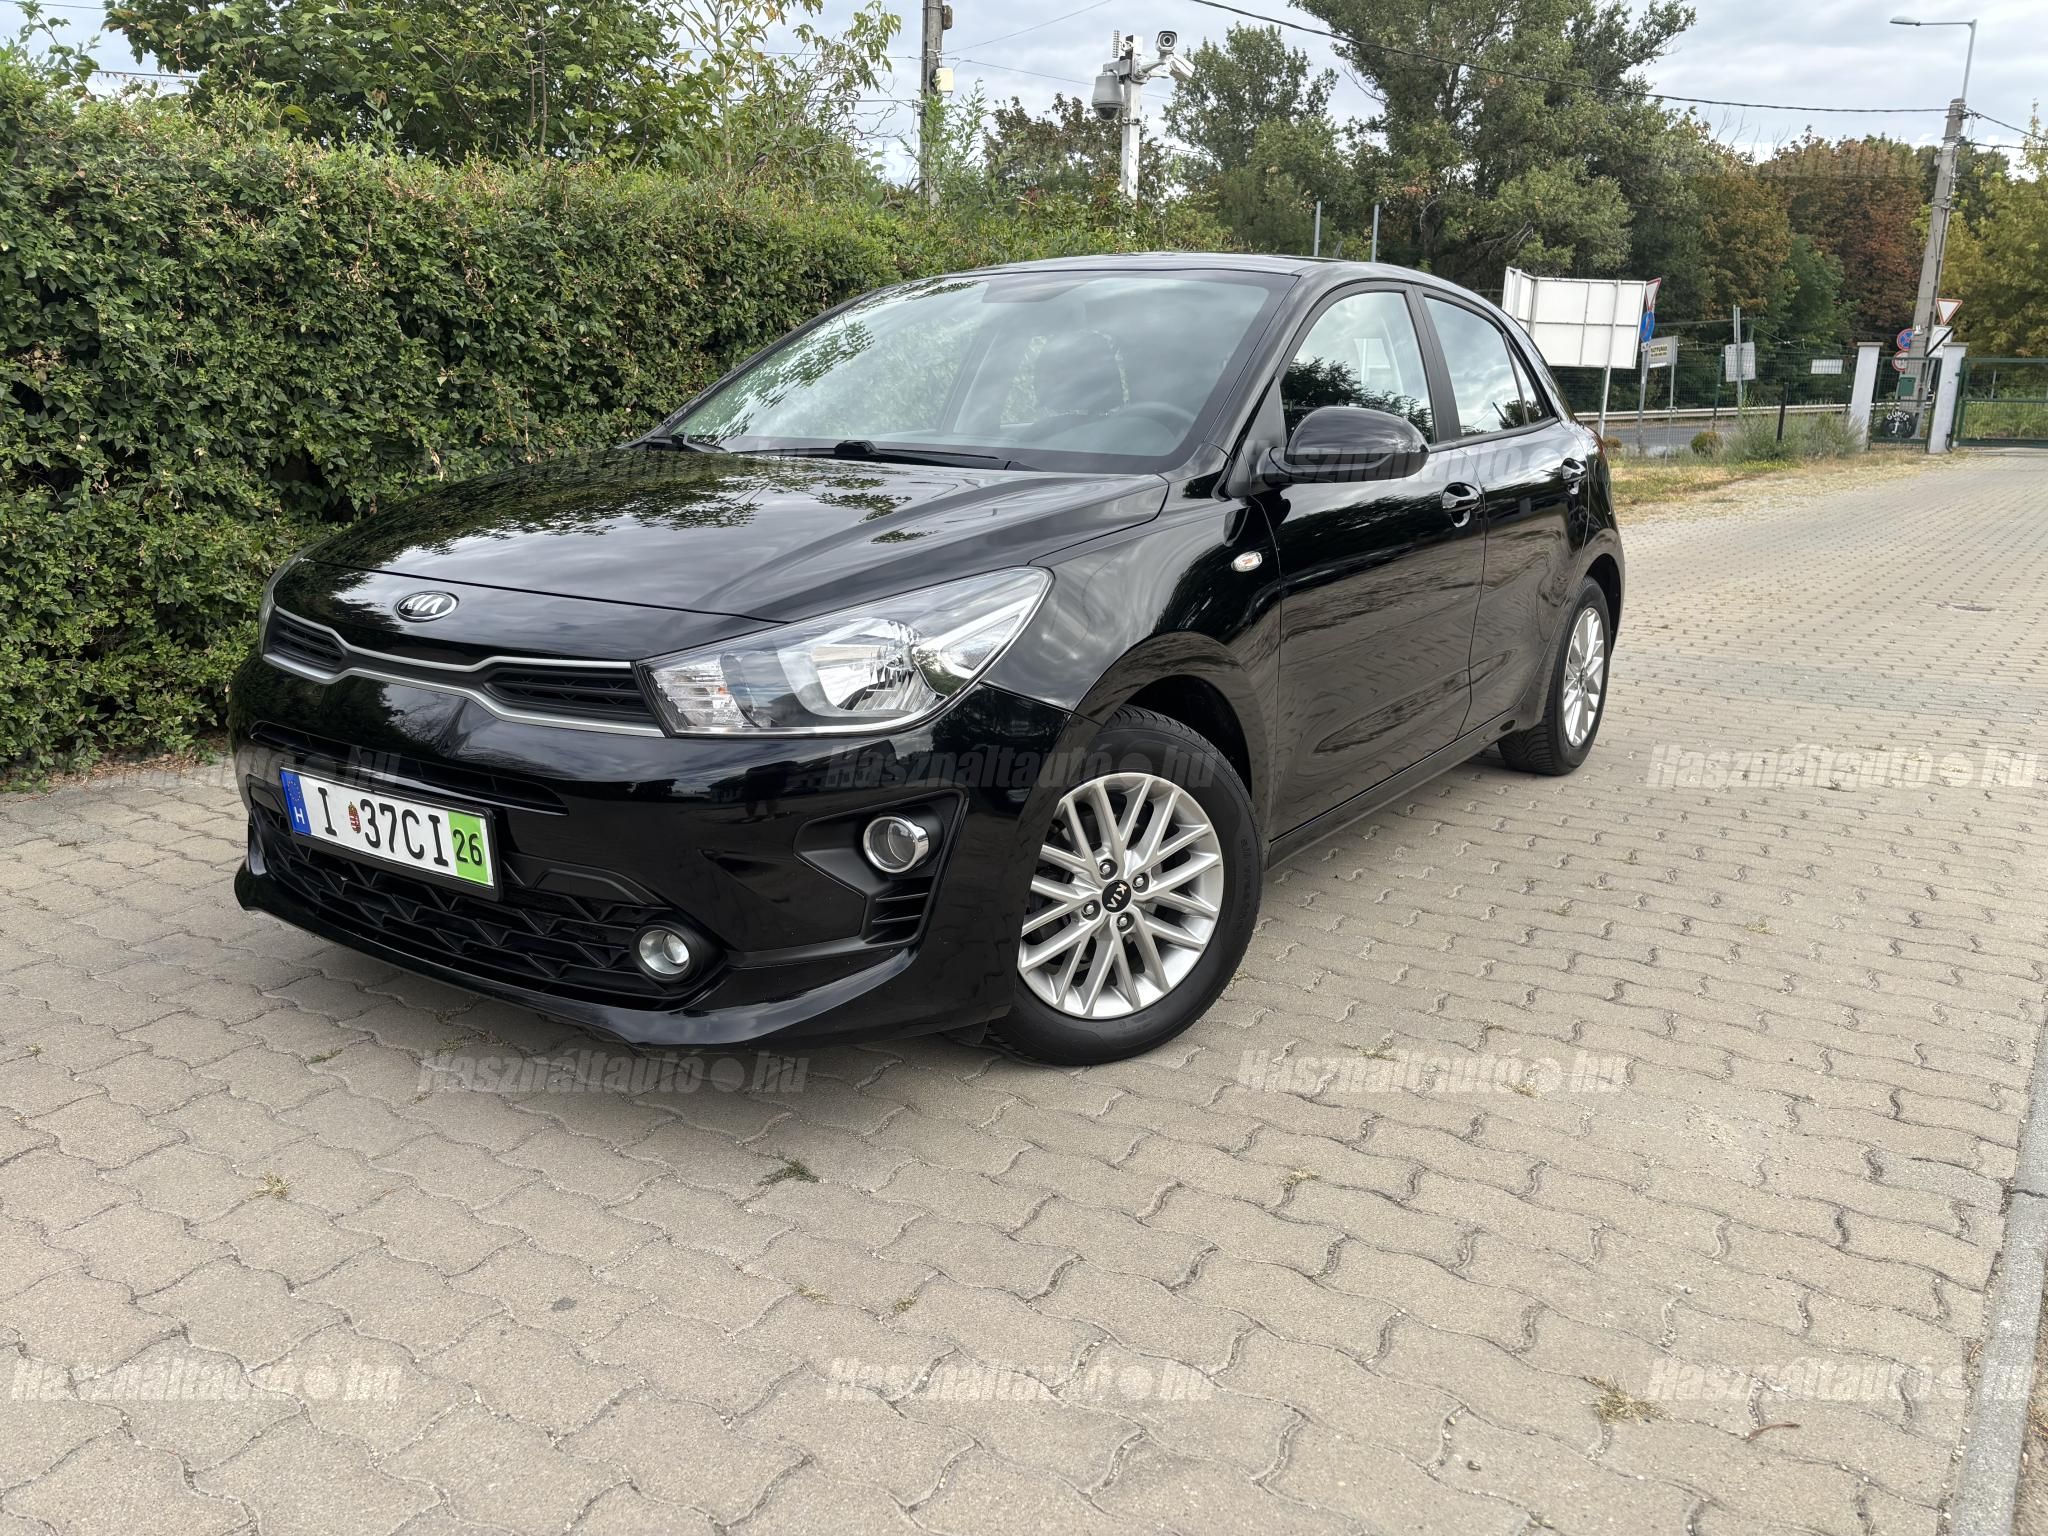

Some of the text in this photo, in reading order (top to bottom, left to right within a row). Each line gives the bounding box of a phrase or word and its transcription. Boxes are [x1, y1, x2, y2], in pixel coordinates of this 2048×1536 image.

[400, 594, 445, 615] KIA
[294, 806, 306, 825] H
[452, 828, 483, 866] 26
[1106, 883, 1127, 908] KIA
